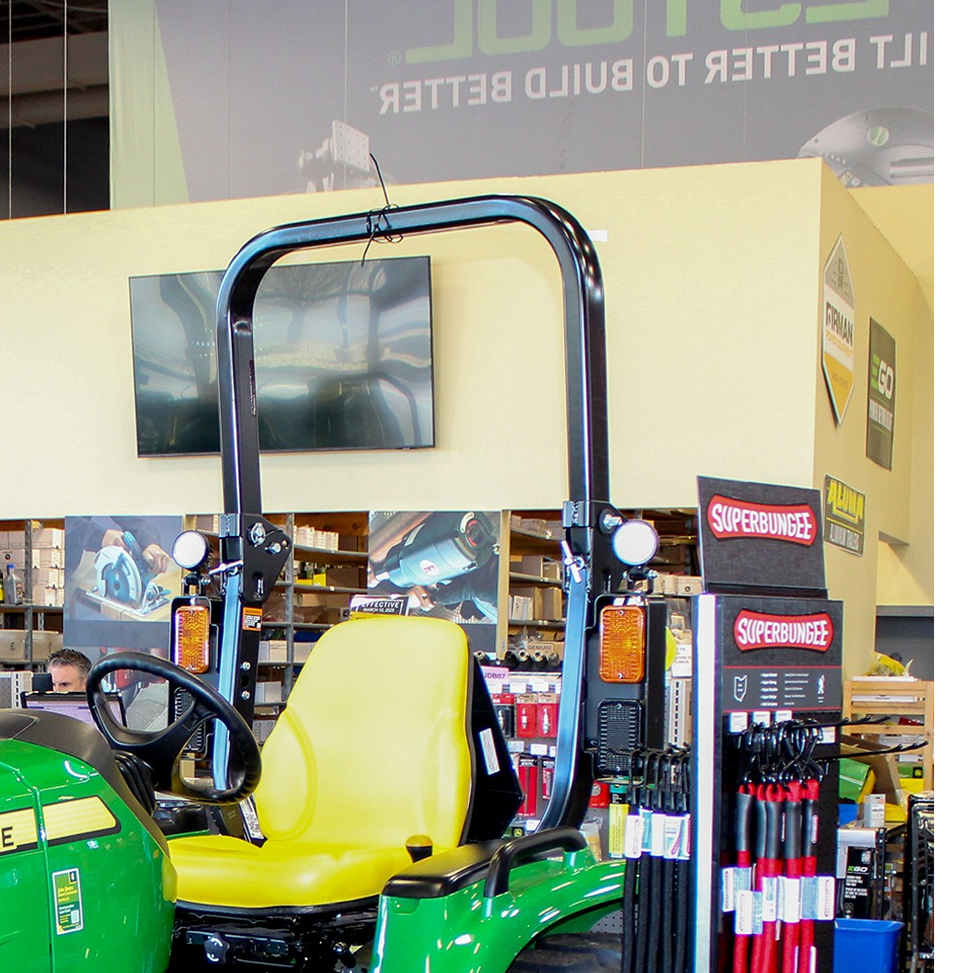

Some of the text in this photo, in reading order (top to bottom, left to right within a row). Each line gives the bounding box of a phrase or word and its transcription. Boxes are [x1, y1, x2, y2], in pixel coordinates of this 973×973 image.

[870, 354, 894, 400] EGO
[711, 503, 812, 540] SUPERBUNGEE
[737, 617, 828, 646] SUPERBUNGEE
[848, 865, 868, 873] EGO
